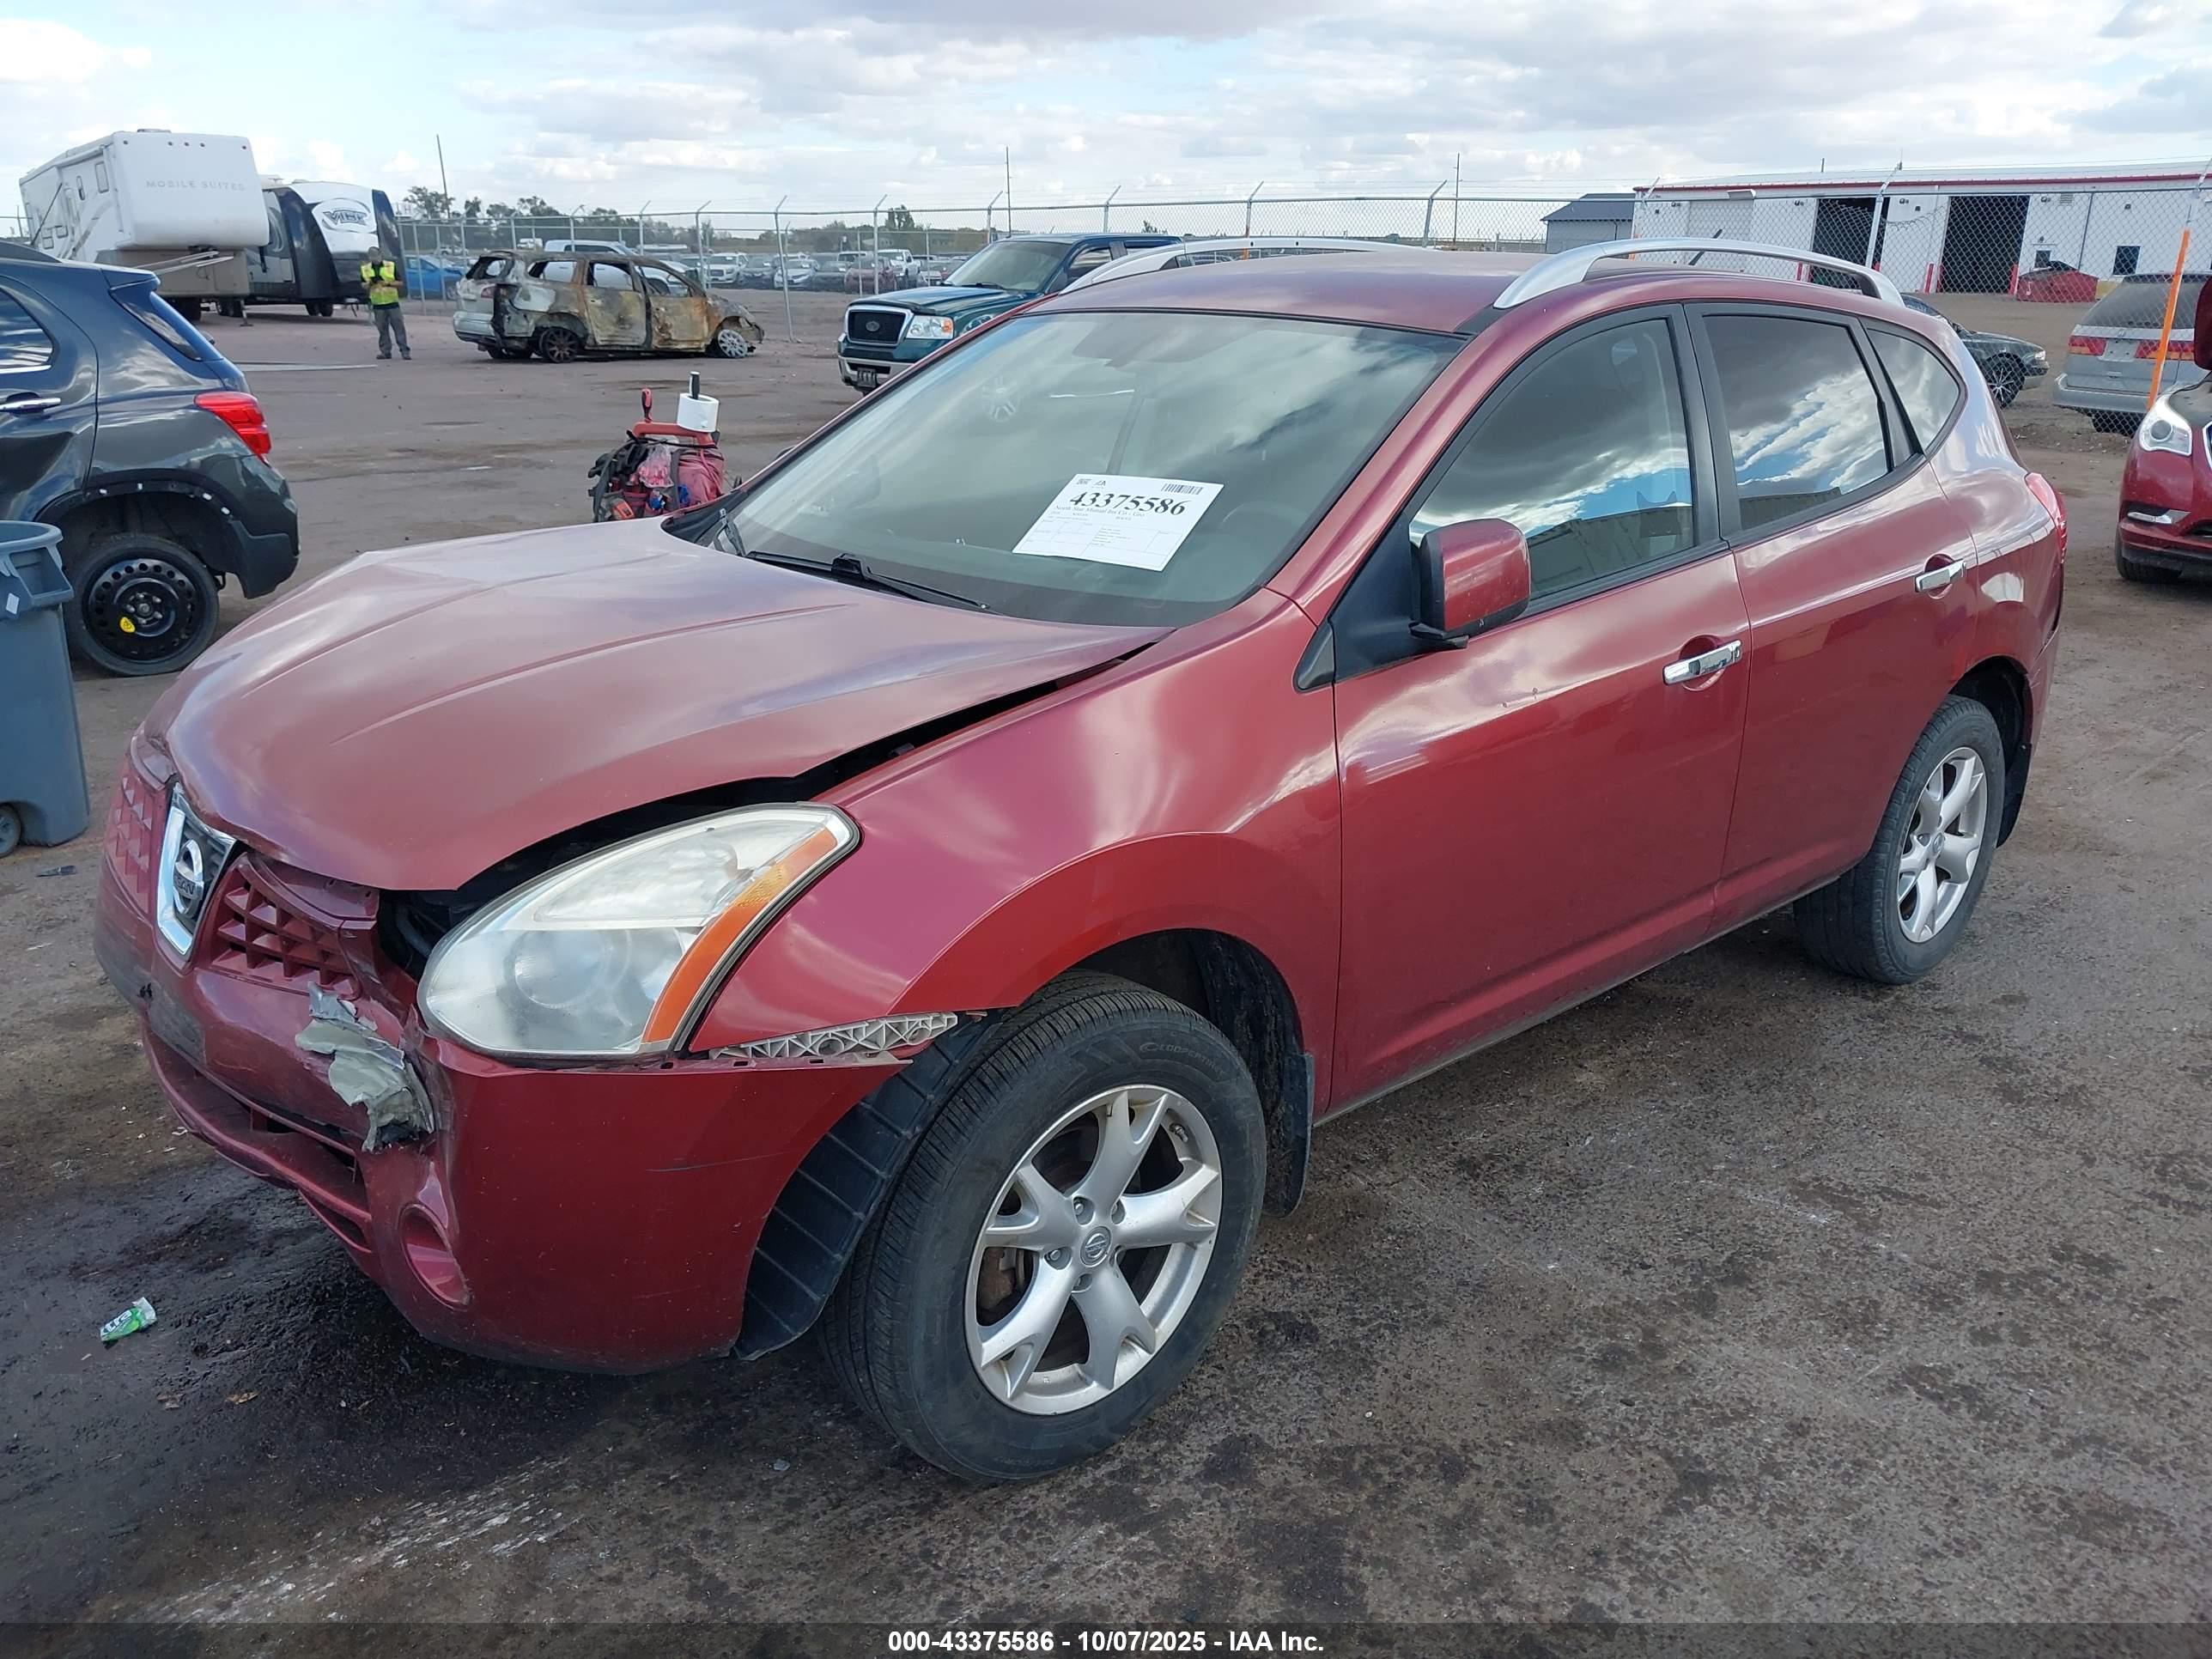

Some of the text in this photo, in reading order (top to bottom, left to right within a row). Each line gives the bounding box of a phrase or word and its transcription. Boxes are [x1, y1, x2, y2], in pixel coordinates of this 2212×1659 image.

[146, 179, 246, 191] MOBILE SUITES
[1070, 491, 1192, 517] 43375586
